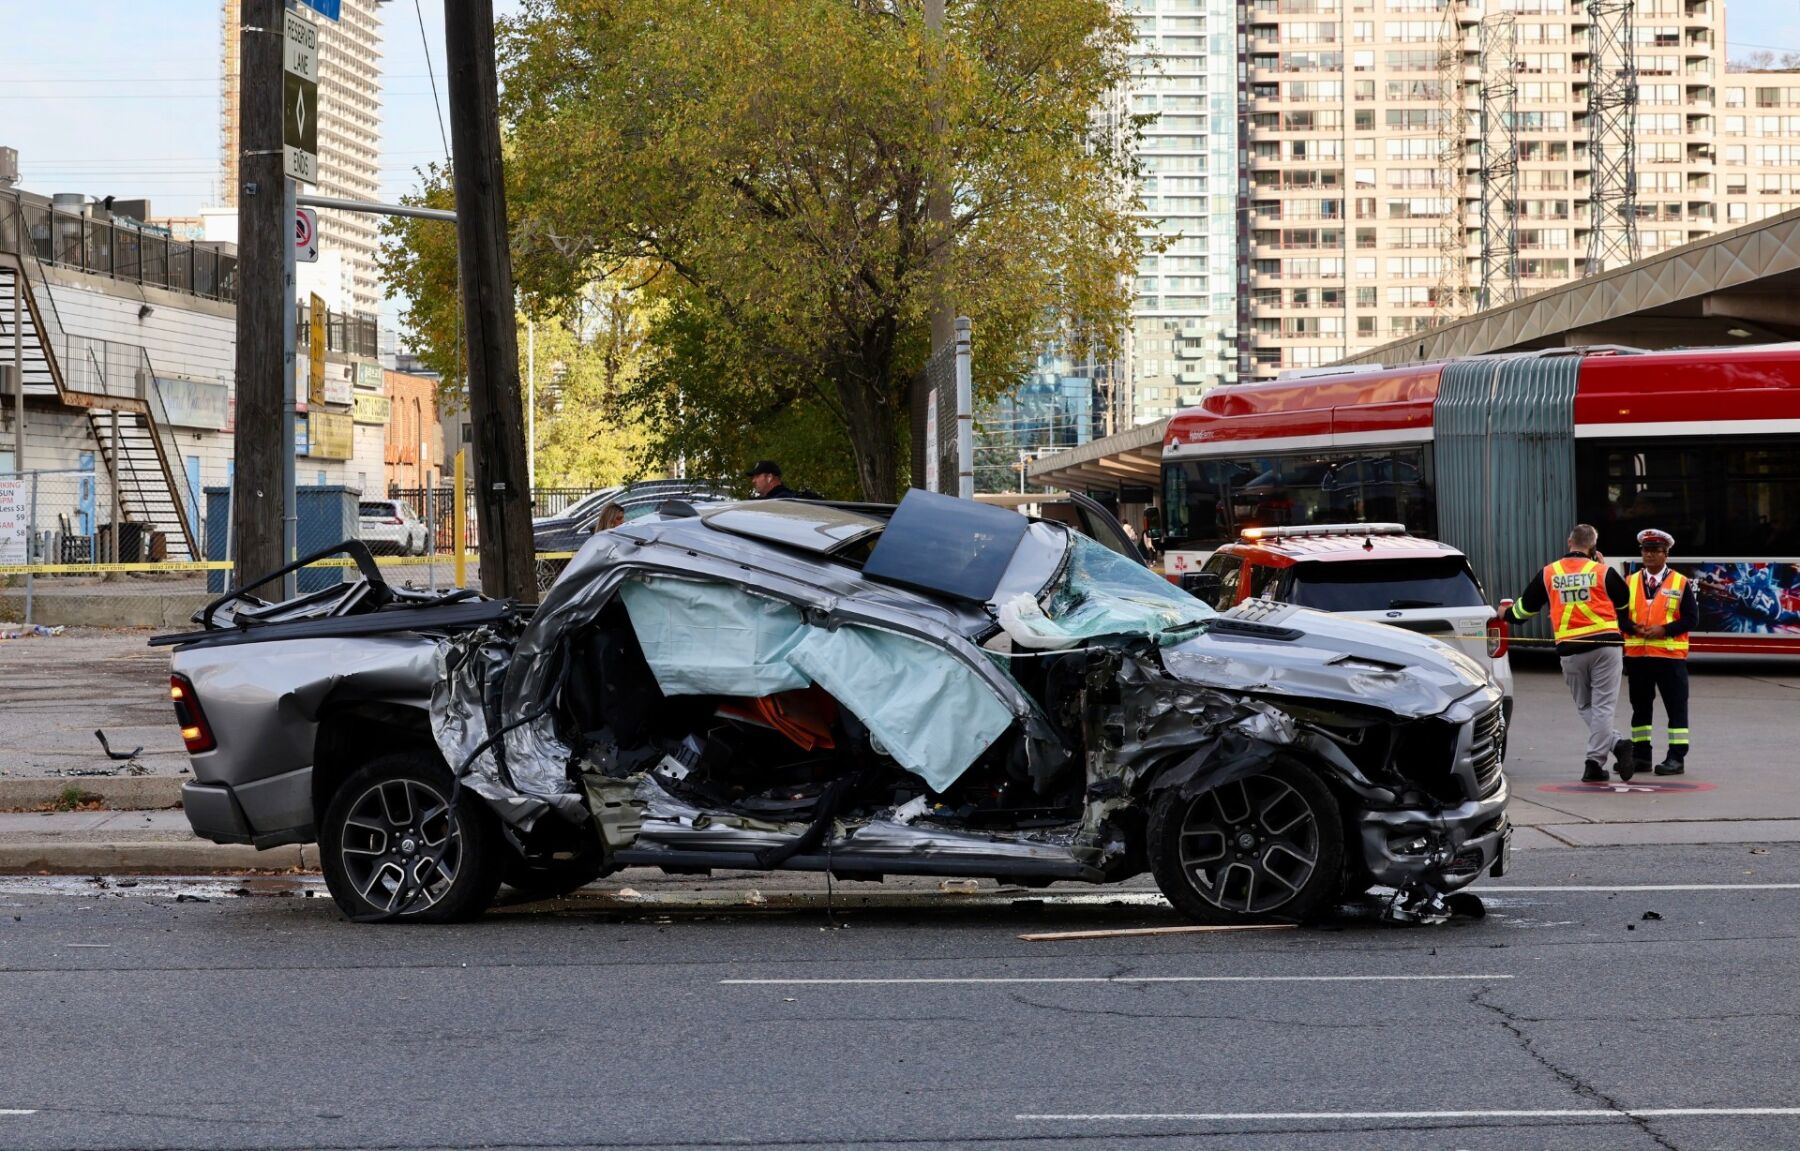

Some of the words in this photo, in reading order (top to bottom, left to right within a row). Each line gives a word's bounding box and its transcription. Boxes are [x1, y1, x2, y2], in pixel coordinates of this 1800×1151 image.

[288, 18, 316, 50] RESERVED
[293, 50, 309, 75] LANE
[293, 151, 309, 176] ENDS
[16, 504, 25, 512] $3
[16, 513, 25, 521] $9
[1552, 573, 1595, 589] SAFETY
[1561, 588, 1589, 603] TTC
